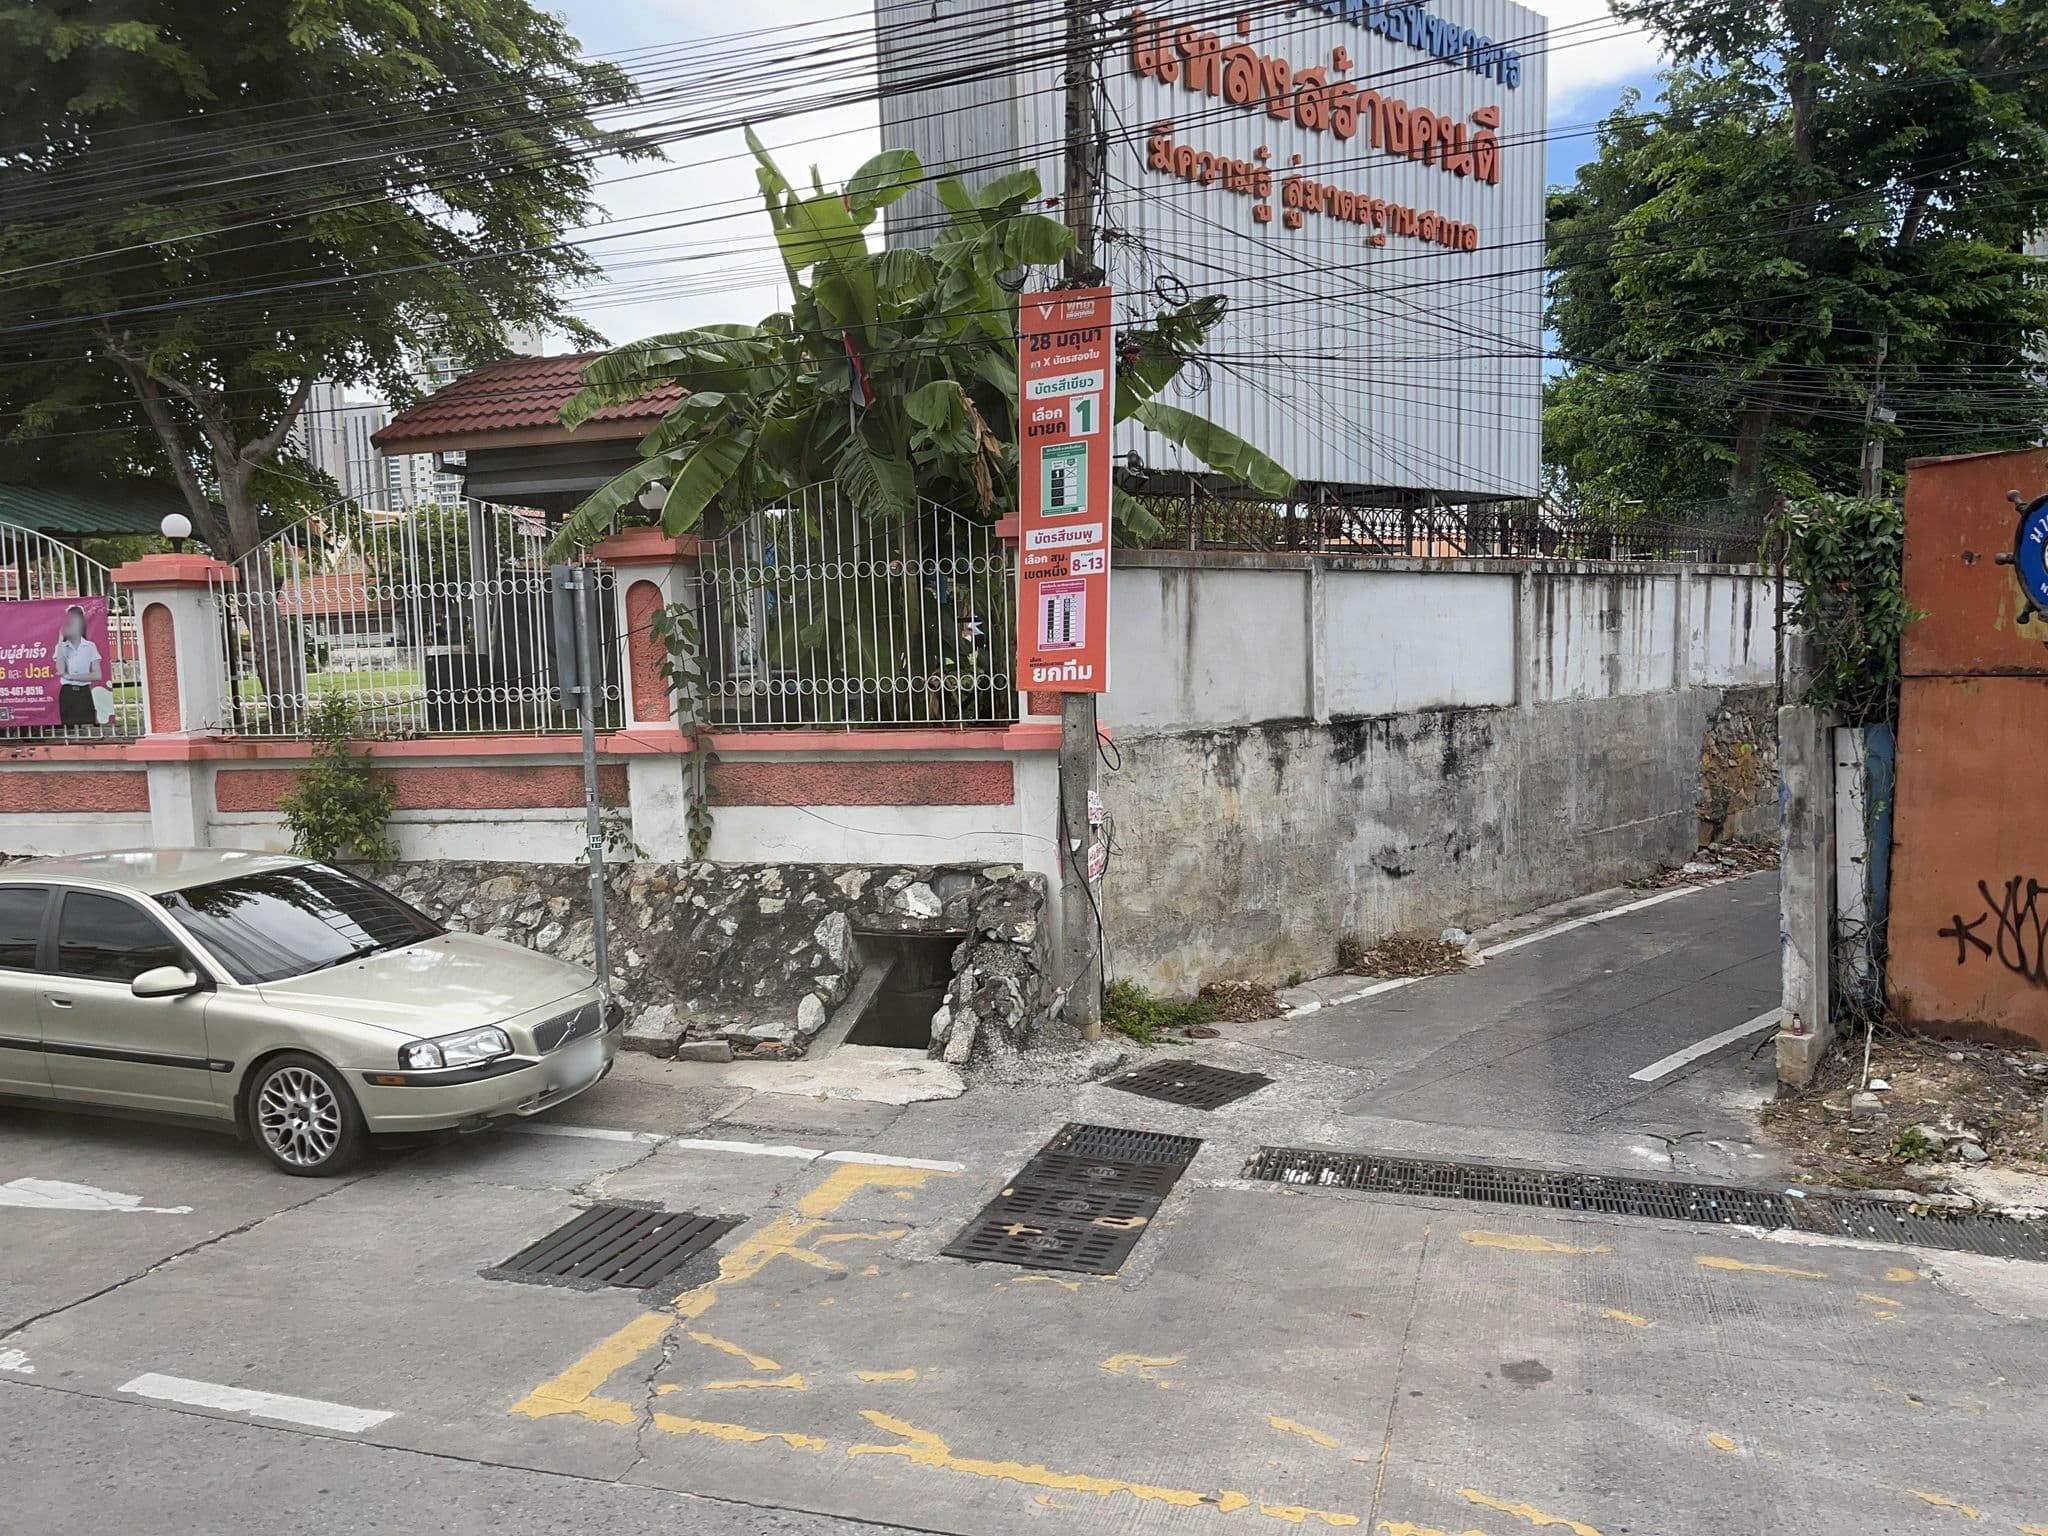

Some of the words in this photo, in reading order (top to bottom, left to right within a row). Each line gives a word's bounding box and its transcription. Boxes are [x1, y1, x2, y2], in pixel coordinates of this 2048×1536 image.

[1131, 9, 1500, 185] แหล่งสร้างคนดี
[1148, 120, 1272, 222] มีความรู้
[1283, 154, 1478, 252] สู่มาตรฐานสากล
[1030, 335, 1051, 352] 28
[1053, 349, 1100, 366] บัตรสองใบ
[1035, 376, 1094, 395] บัตรสีเขียว
[1032, 407, 1063, 422] เลือก
[1075, 399, 1091, 432] 1
[1028, 422, 1067, 437] นายก
[1035, 529, 1093, 544] บัตรสีชมพู
[1024, 553, 1048, 565] เลือก
[1072, 557, 1103, 572] 8-13
[1024, 561, 1068, 579] เขตหนึ่ง
[25, 663, 54, 679] ปวส.
[1033, 659, 1092, 683] ยกทีม
